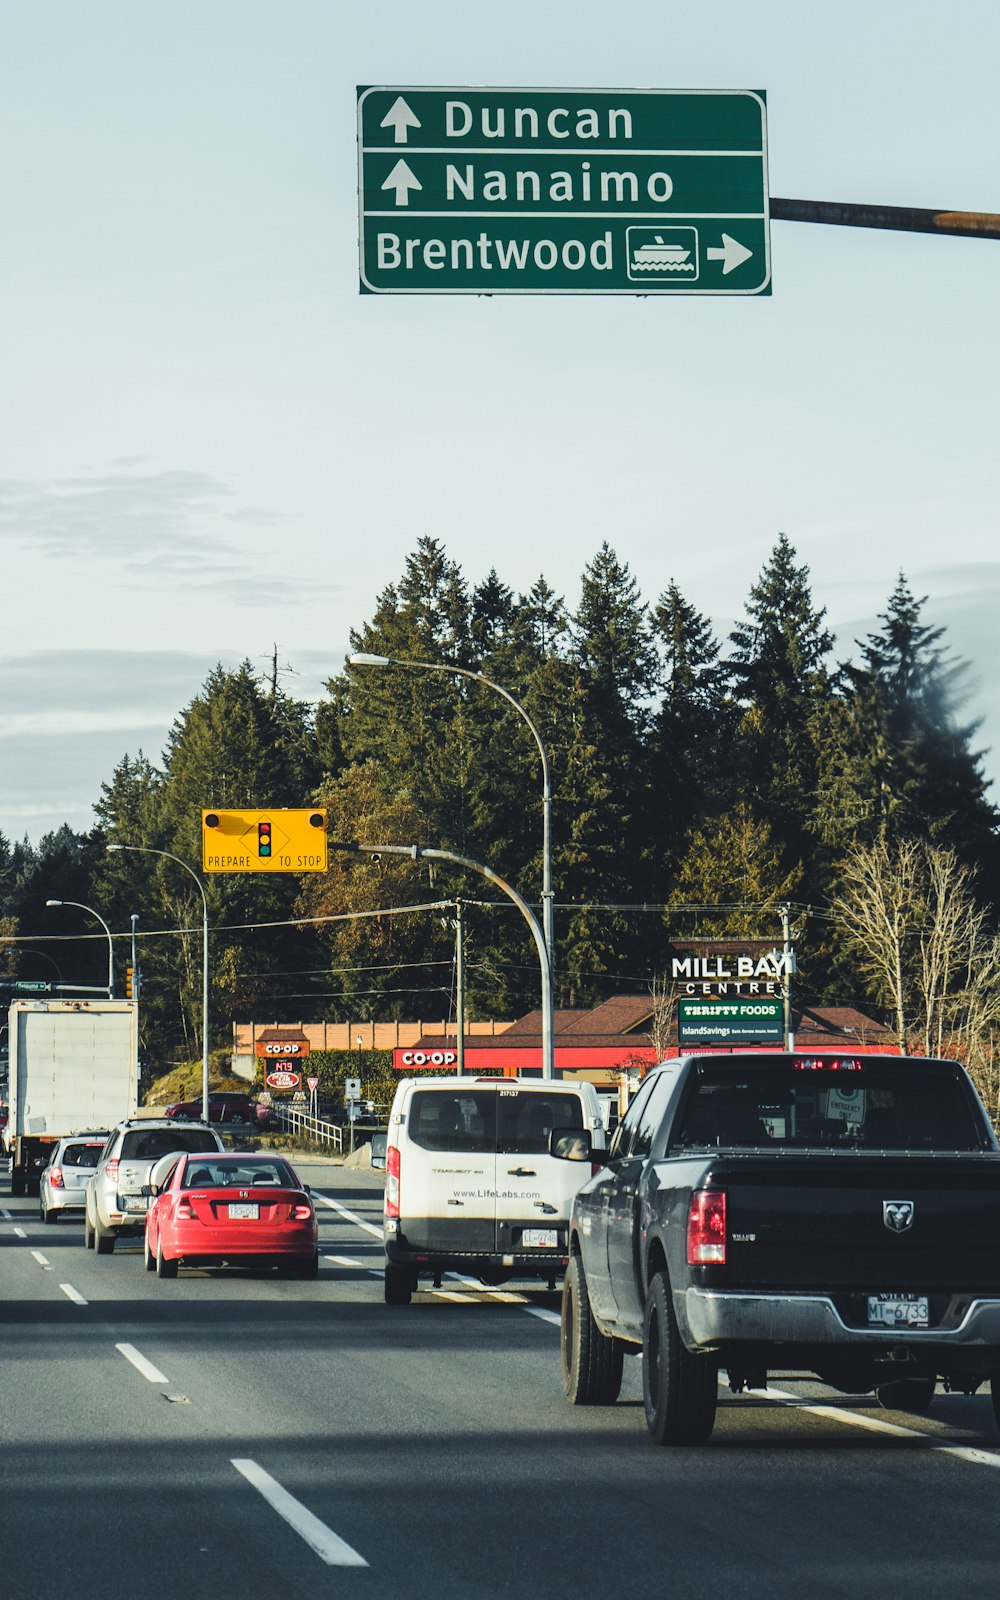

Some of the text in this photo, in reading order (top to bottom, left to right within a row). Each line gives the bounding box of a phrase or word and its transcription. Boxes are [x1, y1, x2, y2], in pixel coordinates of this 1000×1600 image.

[446, 101, 634, 139] Duncan
[446, 161, 674, 202] Nanaimo
[377, 231, 613, 271] Brentwood
[208, 856, 322, 867] PREPARE TO STOP
[672, 957, 787, 978] MILL BAY
[686, 982, 775, 994] CENTRE
[684, 1005, 777, 1016] THRIFTY FOODS
[682, 1026, 731, 1037] IslandSavings
[831, 1101, 860, 1113] EMERGENCY
[838, 1110, 852, 1119] ONLY
[453, 1189, 541, 1199] www.LifeLabs.com
